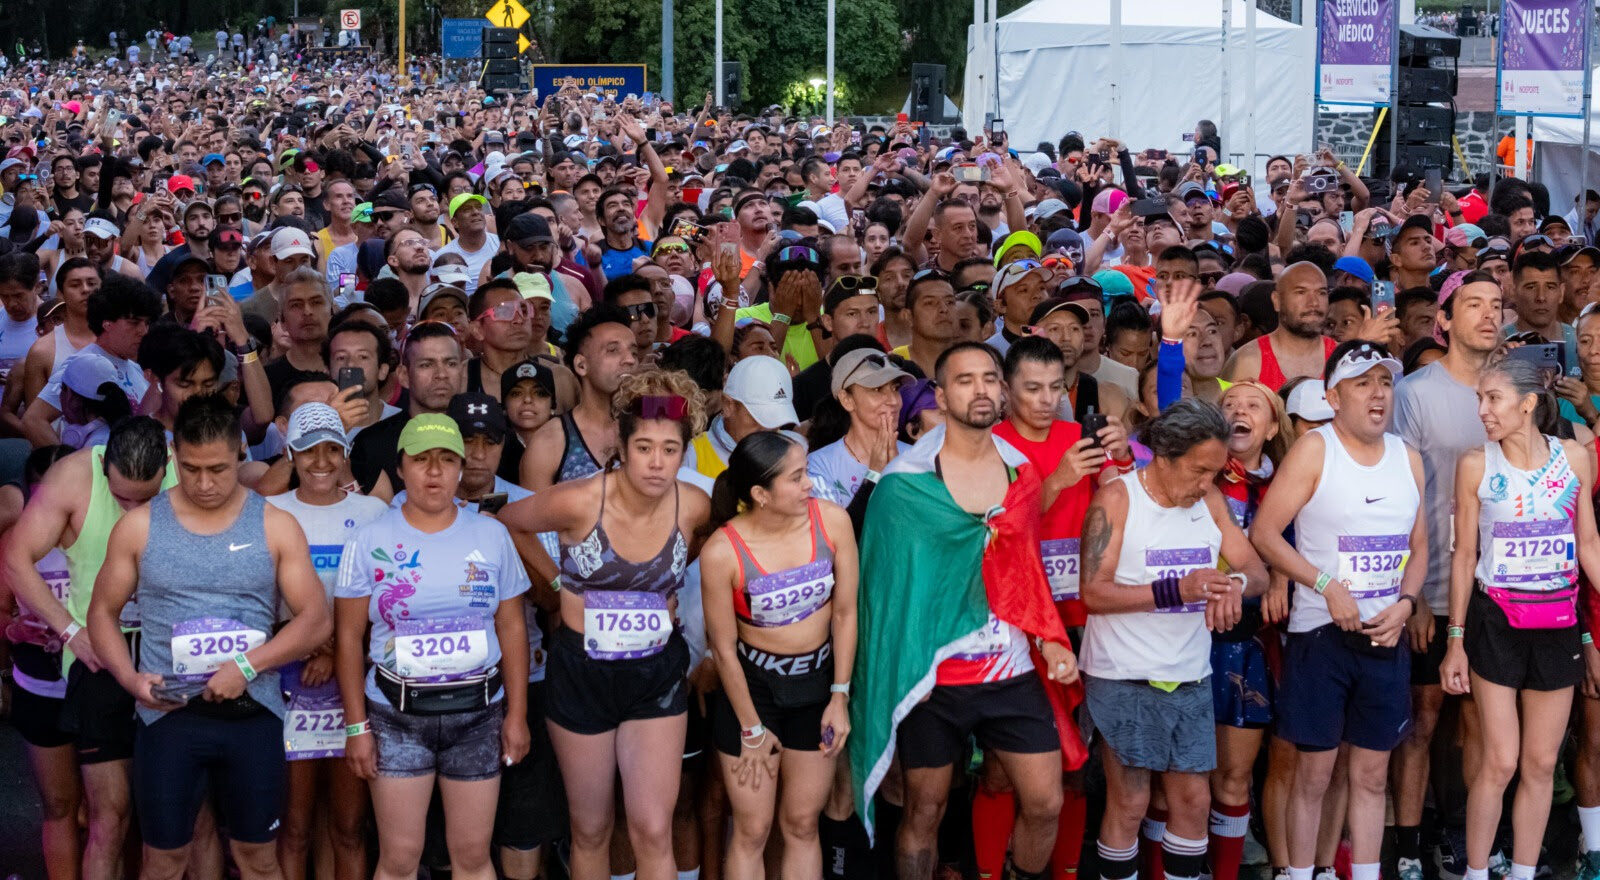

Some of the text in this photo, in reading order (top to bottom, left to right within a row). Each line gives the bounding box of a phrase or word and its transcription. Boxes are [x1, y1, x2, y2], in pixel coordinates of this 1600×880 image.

[1336, 0, 1379, 17] SERVICIO
[1338, 18, 1375, 42] MÉDICO
[1519, 8, 1570, 35] JUECES
[587, 75, 625, 86] OLÍMPICO
[1505, 539, 1566, 557] 21720
[1349, 553, 1403, 572] 13320
[761, 582, 826, 611] 23293
[595, 612, 661, 632] 17630
[189, 634, 249, 657] 3205
[411, 635, 471, 657] 3204
[738, 641, 815, 676] NIKE
